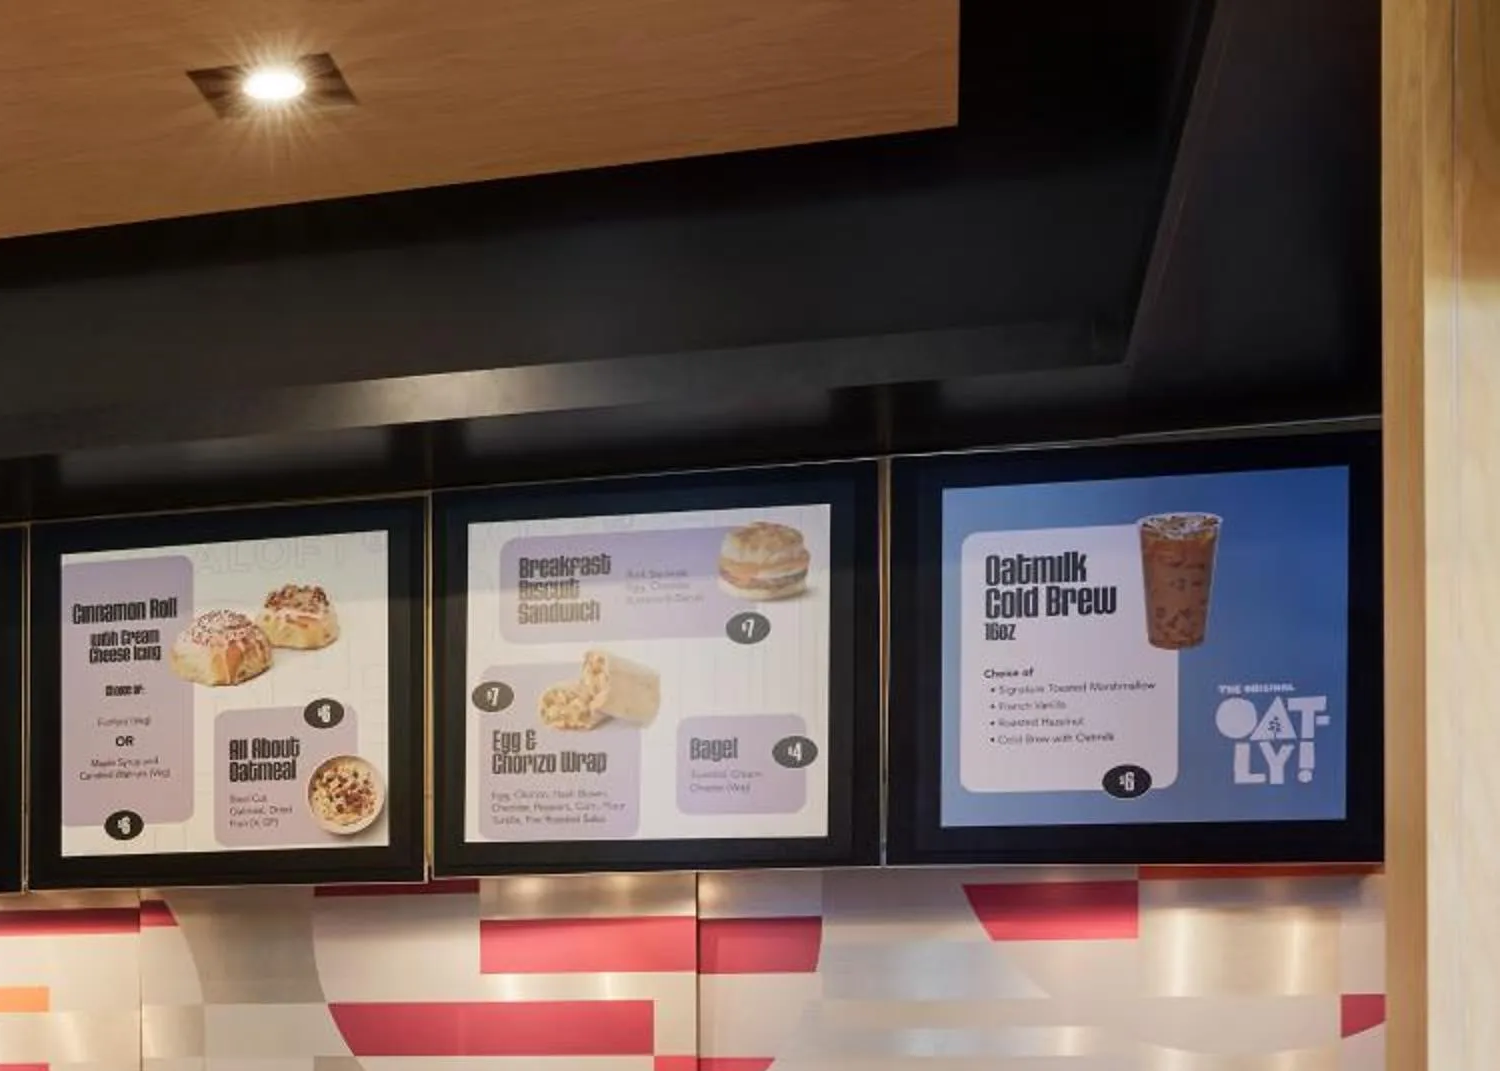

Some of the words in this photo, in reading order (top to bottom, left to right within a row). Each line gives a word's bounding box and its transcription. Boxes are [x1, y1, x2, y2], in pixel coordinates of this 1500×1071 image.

[518, 552, 612, 579] Breakfast
[985, 551, 1088, 586] Oatmilk
[518, 577, 581, 601] Biscuit
[73, 601, 146, 625] Cinnamon
[150, 597, 178, 619] Roll
[518, 600, 601, 626] Sandwich
[985, 586, 1039, 619] Cold
[1045, 585, 1117, 618] Brew
[120, 629, 160, 645] Cream
[89, 646, 131, 664] Cheese
[133, 645, 161, 661] Icing
[1089, 680, 1156, 693] Marshmallow
[115, 735, 135, 747] OR
[229, 739, 248, 760] All
[252, 736, 300, 759] About
[492, 729, 521, 754] Egg
[689, 737, 739, 762] Bagel
[229, 759, 297, 782] Oatmeal
[491, 752, 557, 775] Chorizo
[560, 751, 607, 775] Wrap
